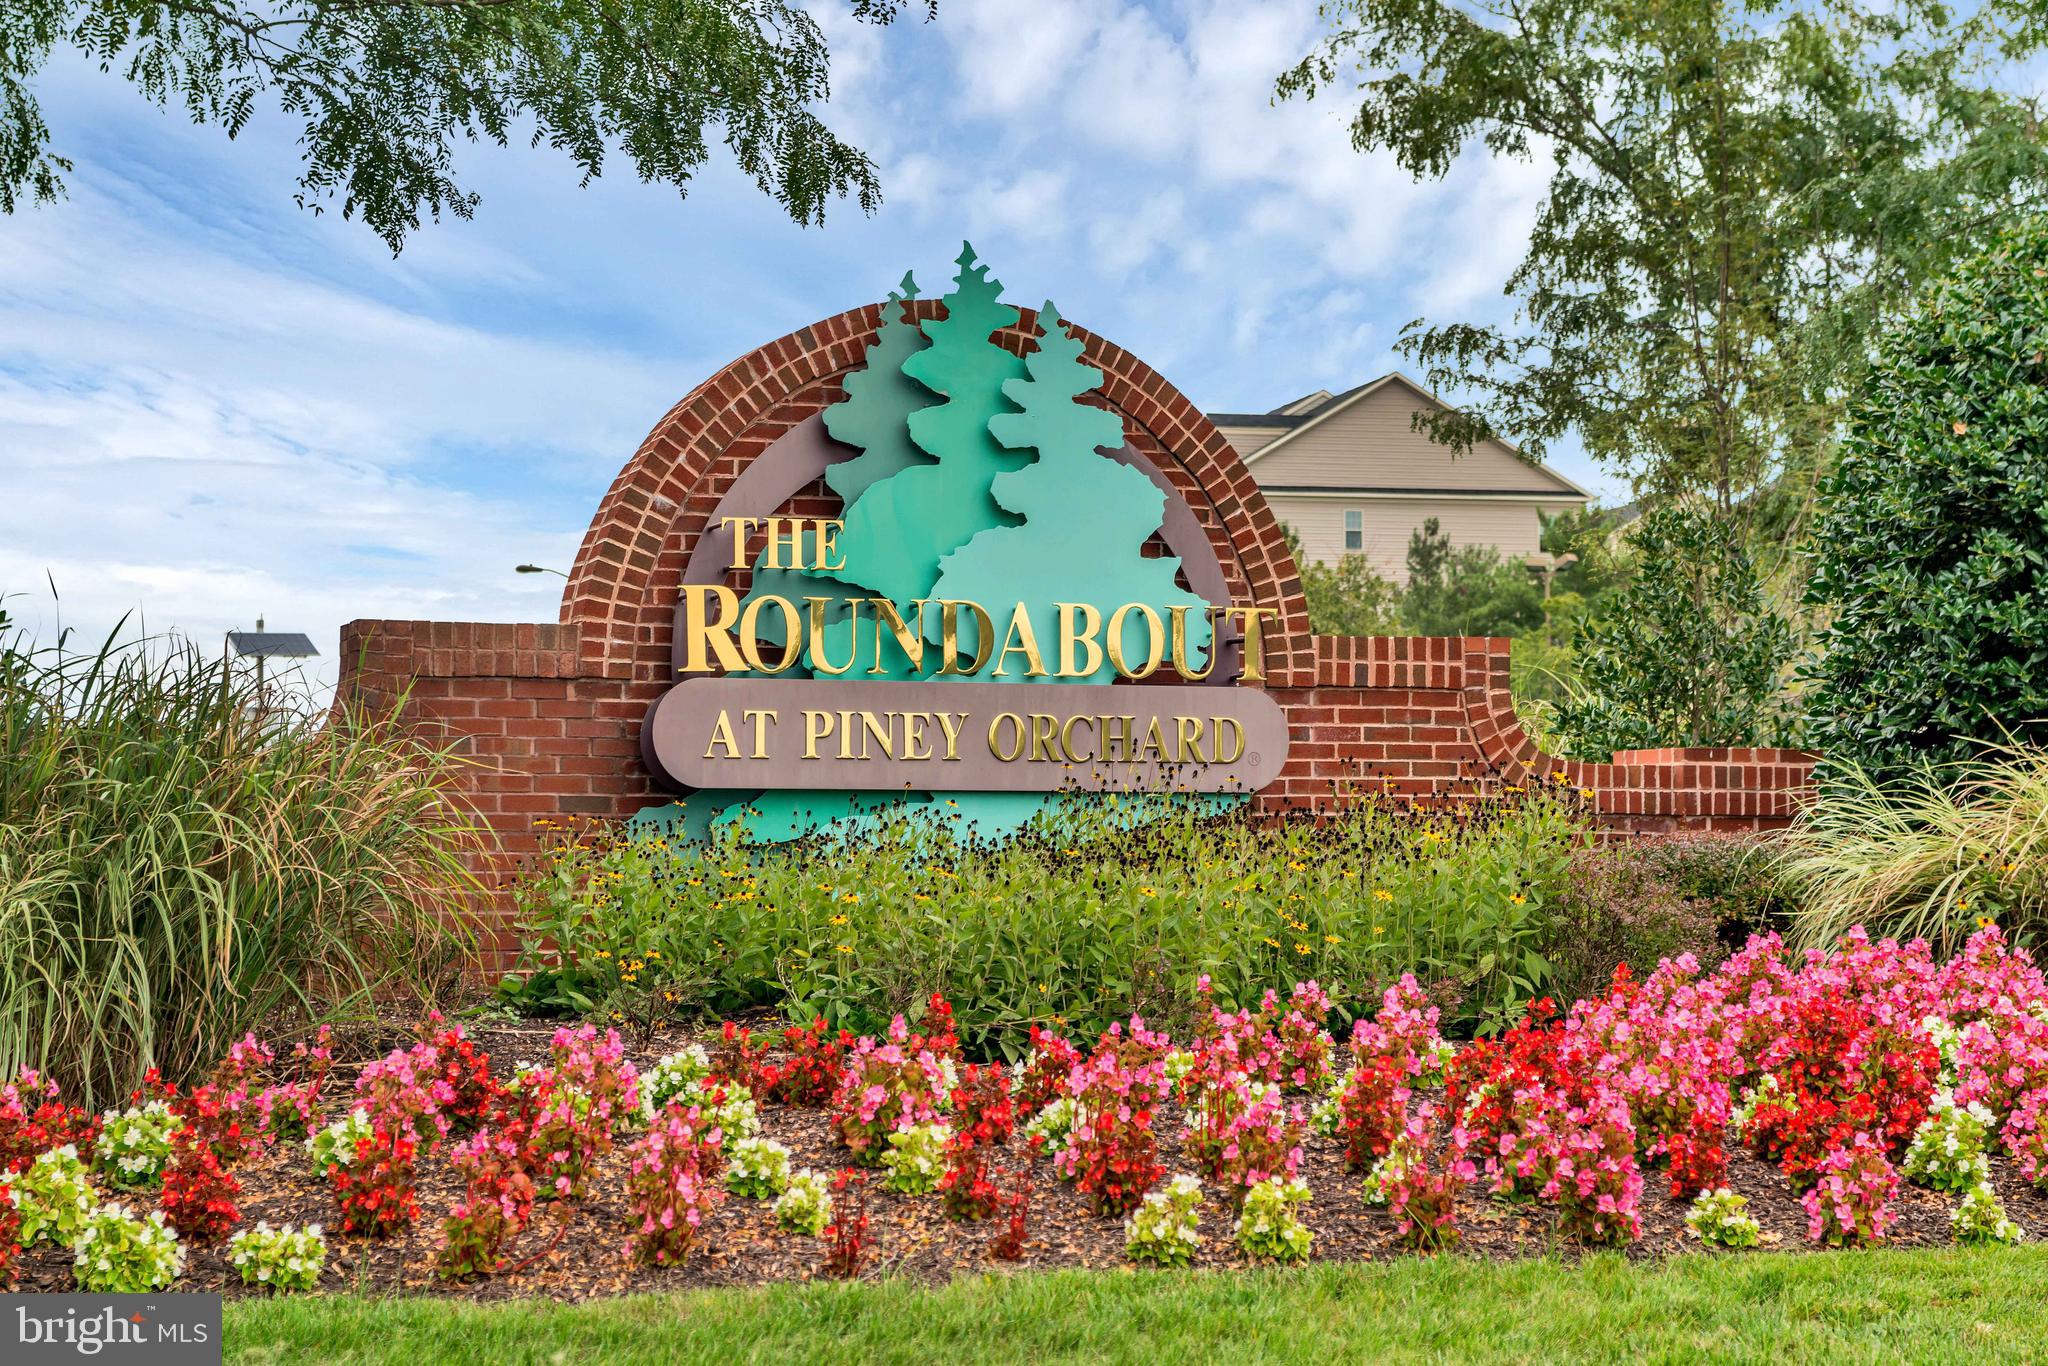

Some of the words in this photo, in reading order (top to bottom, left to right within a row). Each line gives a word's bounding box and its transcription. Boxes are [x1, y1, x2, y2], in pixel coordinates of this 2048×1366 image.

[720, 516, 847, 572] THE
[676, 584, 1279, 681] ROUNDABOUT
[702, 709, 778, 760] AT
[800, 710, 969, 762] PINEY
[987, 712, 1245, 765] ORCHARD
